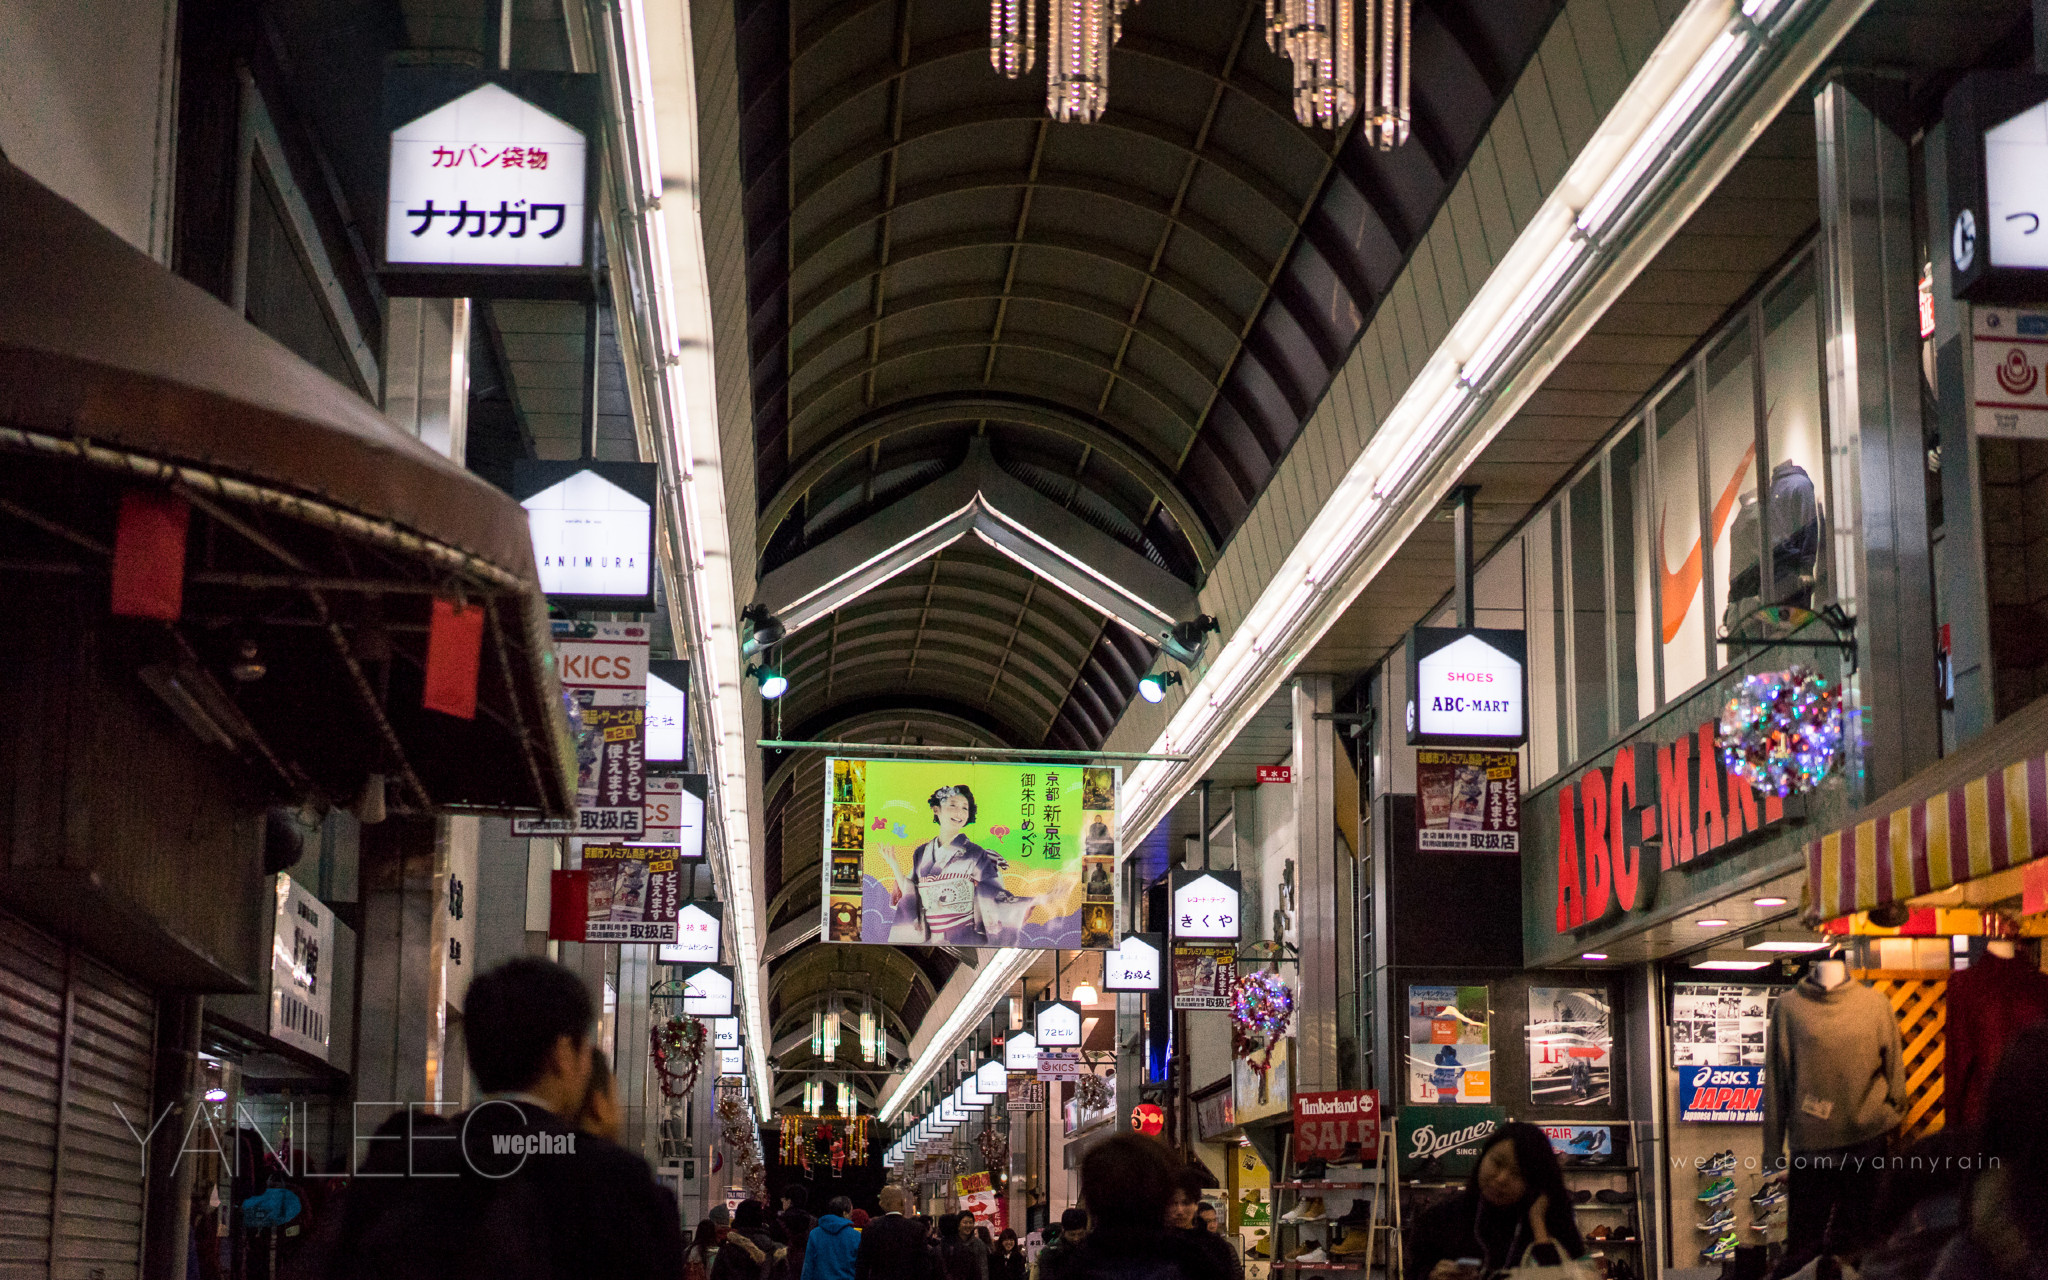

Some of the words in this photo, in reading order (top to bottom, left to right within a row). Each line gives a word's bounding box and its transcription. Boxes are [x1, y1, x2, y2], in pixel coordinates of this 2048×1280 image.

[432, 144, 549, 170] カバン袋物
[407, 199, 566, 239] ナカガワ
[563, 655, 631, 680] KICS
[1447, 672, 1494, 683] SHOES
[1432, 697, 1509, 713] ABC-MART
[607, 744, 624, 805] 使えます
[627, 740, 642, 801] どちらも
[1021, 773, 1037, 857] 御朱印めぐり
[1043, 772, 1061, 859] 京都新京極
[1490, 782, 1503, 830] 使えます
[1505, 779, 1517, 827] どちらも
[580, 810, 639, 830] 取扱店
[1470, 833, 1515, 849] 取扱店
[651, 874, 664, 920] 使えます
[666, 871, 678, 918] どちらも
[630, 924, 674, 939] 取扱店
[1181, 914, 1232, 928] きくや
[1539, 1041, 1565, 1063] 1F
[1053, 1064, 1074, 1072] KICS
[1420, 1083, 1436, 1098] 1F
[1689, 1087, 1762, 1110] JAPAN
[1299, 1095, 1357, 1115] Timberland
[1300, 1120, 1376, 1150] SALE
[1409, 1120, 1496, 1158] Danner
